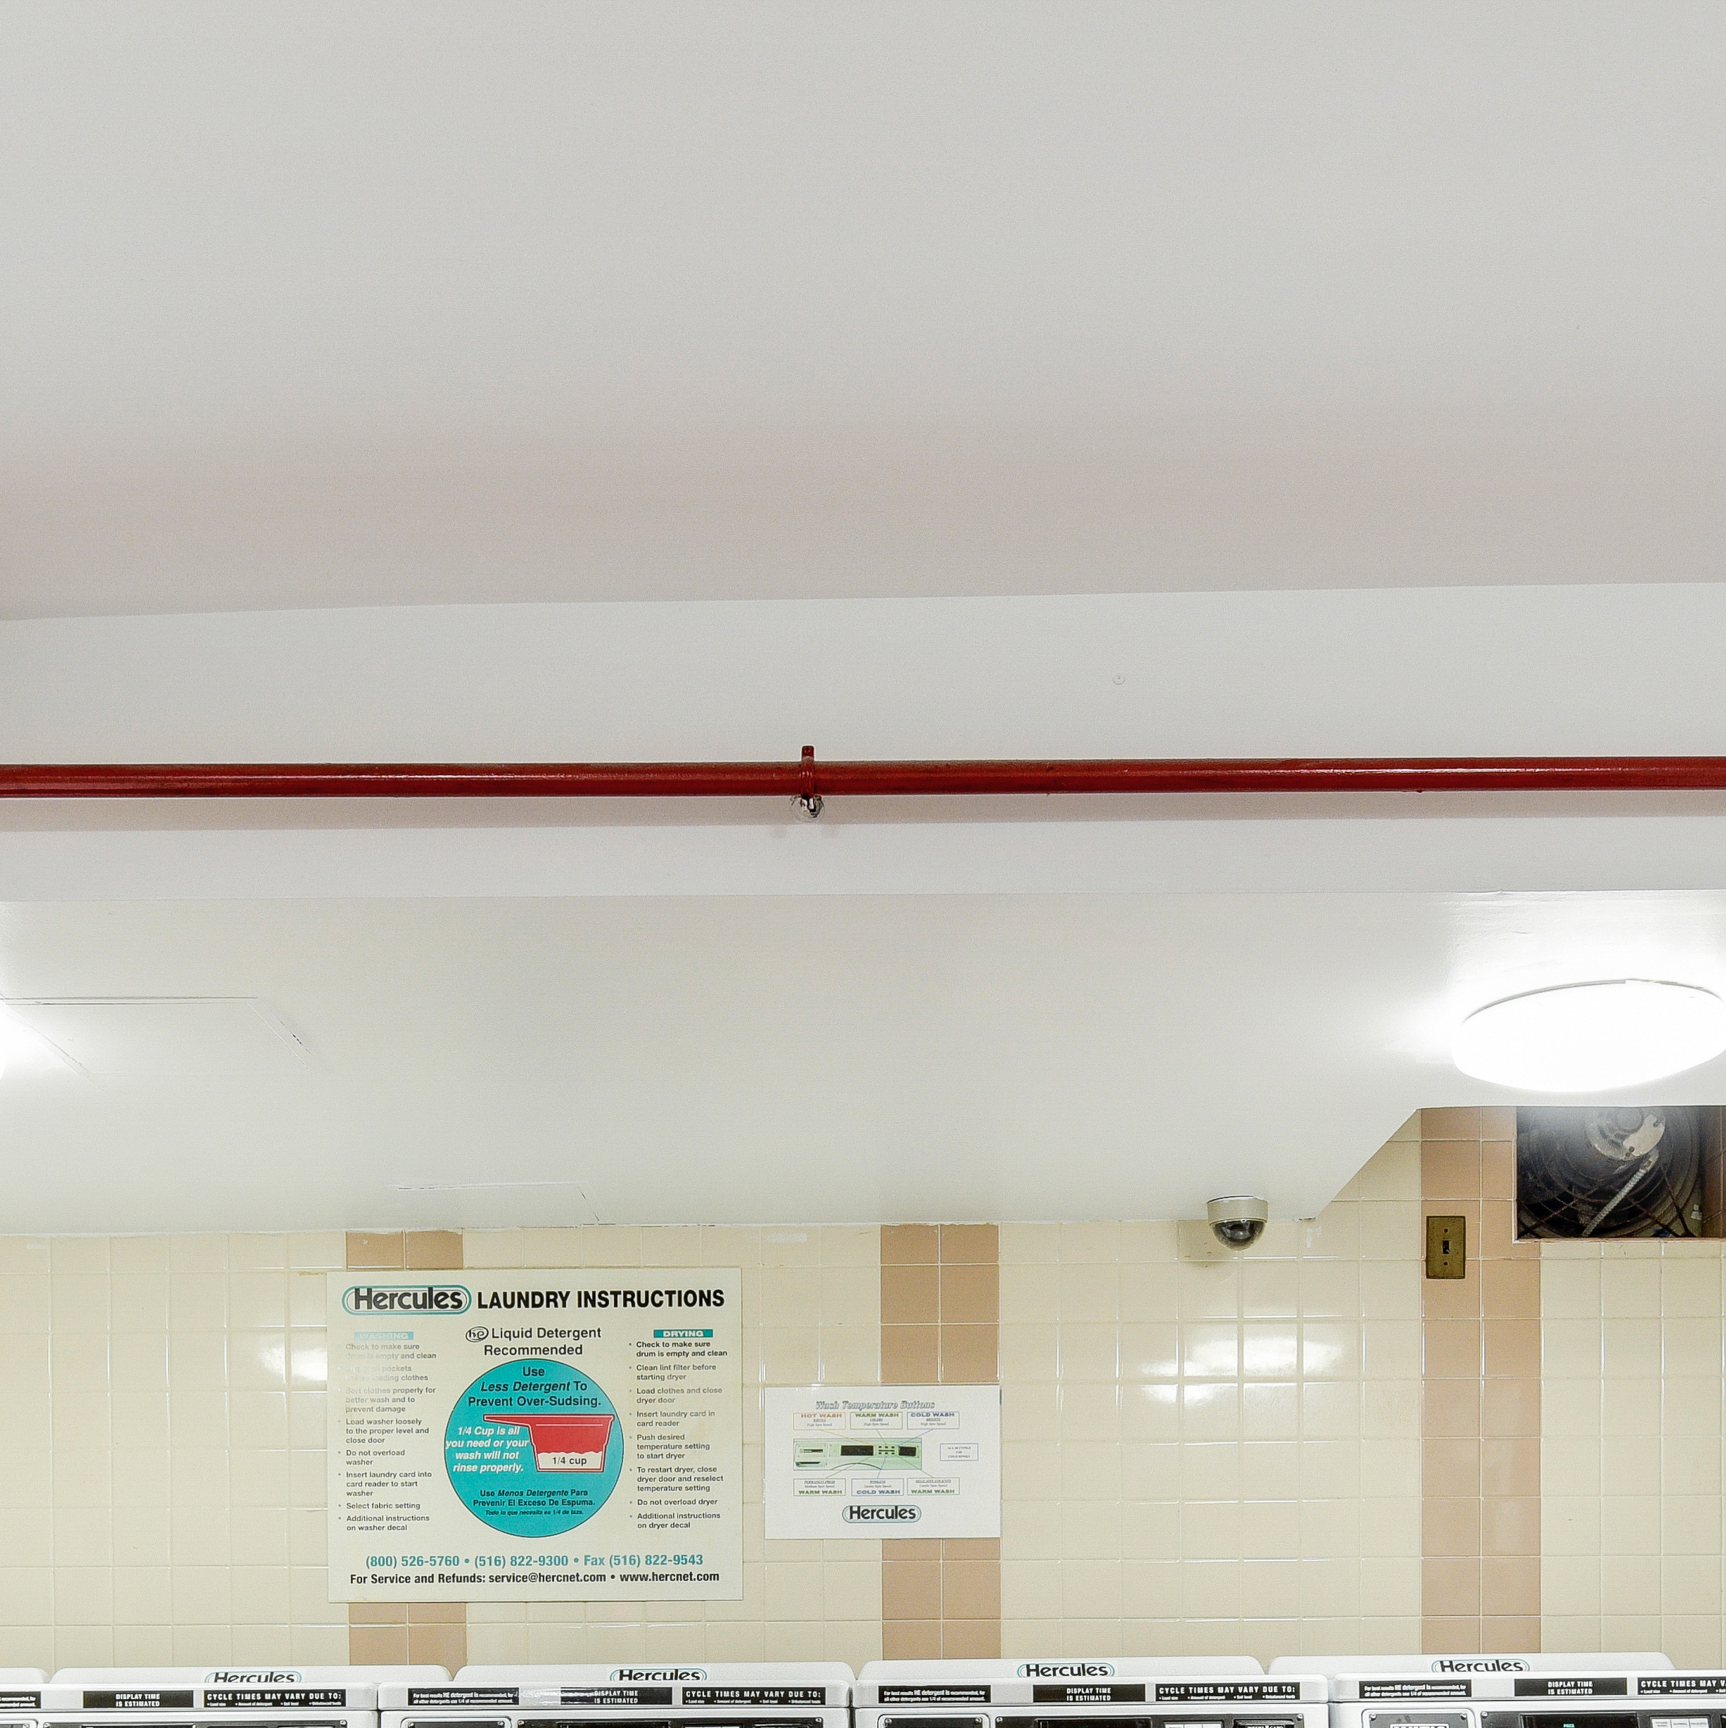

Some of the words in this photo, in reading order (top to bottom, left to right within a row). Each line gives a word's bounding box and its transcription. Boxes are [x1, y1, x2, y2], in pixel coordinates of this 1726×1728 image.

[354, 1287, 463, 1310] Hercules
[477, 1291, 571, 1309] LAUNDRY
[577, 1289, 725, 1308] INSTRUCTIONS
[491, 1328, 533, 1339] Liquid
[537, 1328, 602, 1340] Detergent
[484, 1345, 583, 1356] Recommended
[522, 1367, 545, 1377] Use
[481, 1382, 508, 1391] Less
[513, 1381, 570, 1393] Detergent
[573, 1381, 587, 1390] To
[468, 1397, 513, 1406] Prevent
[517, 1396, 601, 1408] Over-Sudsing.
[815, 1401, 839, 1410] Wash
[842, 1401, 898, 1410] Temperature
[900, 1401, 935, 1409] Buttons
[458, 1426, 472, 1435] 1/4
[474, 1426, 495, 1437] Cup
[497, 1426, 506, 1435] is
[508, 1426, 520, 1435] all
[446, 1439, 464, 1449] you
[467, 1438, 491, 1447] need
[493, 1439, 504, 1447] or
[506, 1439, 530, 1449] your
[455, 1451, 481, 1459] wash
[484, 1451, 500, 1459] will
[503, 1451, 519, 1459] not
[569, 1457, 587, 1466] cup
[453, 1463, 477, 1472] rinse
[480, 1463, 524, 1473] properly.
[850, 1506, 916, 1520] Hercules
[366, 1555, 397, 1569] (800)
[401, 1555, 460, 1566] 526-5760
[474, 1555, 506, 1569] (516)
[510, 1555, 568, 1566] 822-9300
[584, 1555, 605, 1566] Fax
[609, 1555, 641, 1568] (516)
[645, 1554, 703, 1565] 822-9543
[350, 1574, 367, 1584] For
[371, 1573, 411, 1584] Service
[414, 1573, 434, 1583] and
[438, 1573, 485, 1583] Refunds:
[489, 1572, 606, 1583] service@hercnet.com
[620, 1572, 720, 1582] www.hercnet.com
[1025, 1663, 1109, 1677] Hercules
[1440, 1660, 1524, 1673] Hercules
[214, 1671, 295, 1683] Hercules
[619, 1669, 701, 1681] Hercules
[1641, 1680, 1667, 1688] CYCLE
